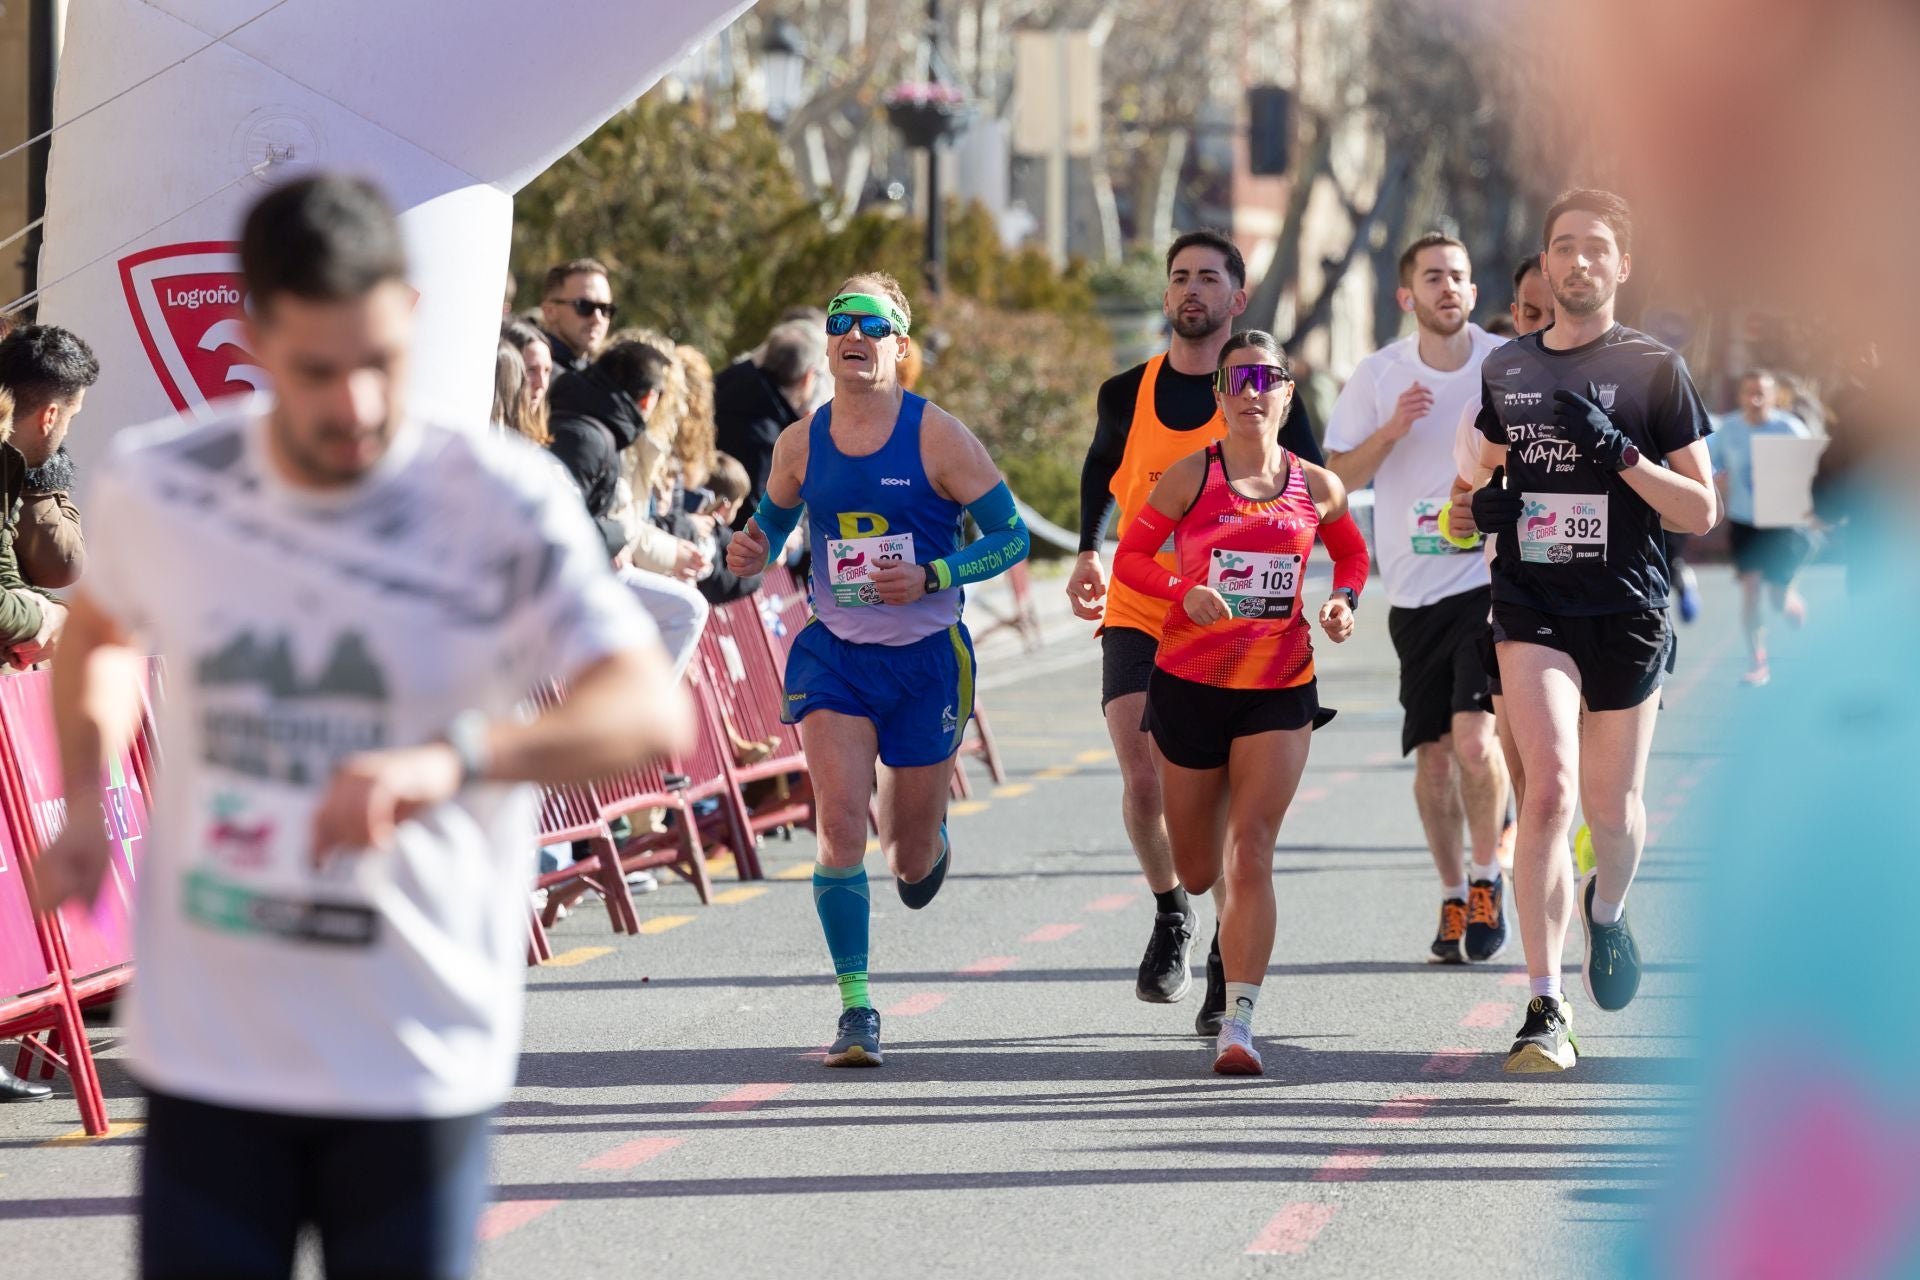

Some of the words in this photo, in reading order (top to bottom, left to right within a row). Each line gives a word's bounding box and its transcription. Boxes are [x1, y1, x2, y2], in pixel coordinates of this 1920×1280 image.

[167, 285, 240, 309] Logroño
[1519, 439, 1582, 473] VIANA
[1572, 505, 1595, 515] 10Km
[1536, 526, 1558, 540] CORRE
[1565, 518, 1601, 538] 392
[879, 542, 903, 552] 10Km
[958, 550, 1003, 577] MARATÓN
[1002, 536, 1026, 562] RIOJA
[1268, 560, 1292, 569] 10Km
[846, 565, 868, 581] CORRE
[1260, 571, 1293, 590] 103
[1229, 579, 1253, 591] CORRE
